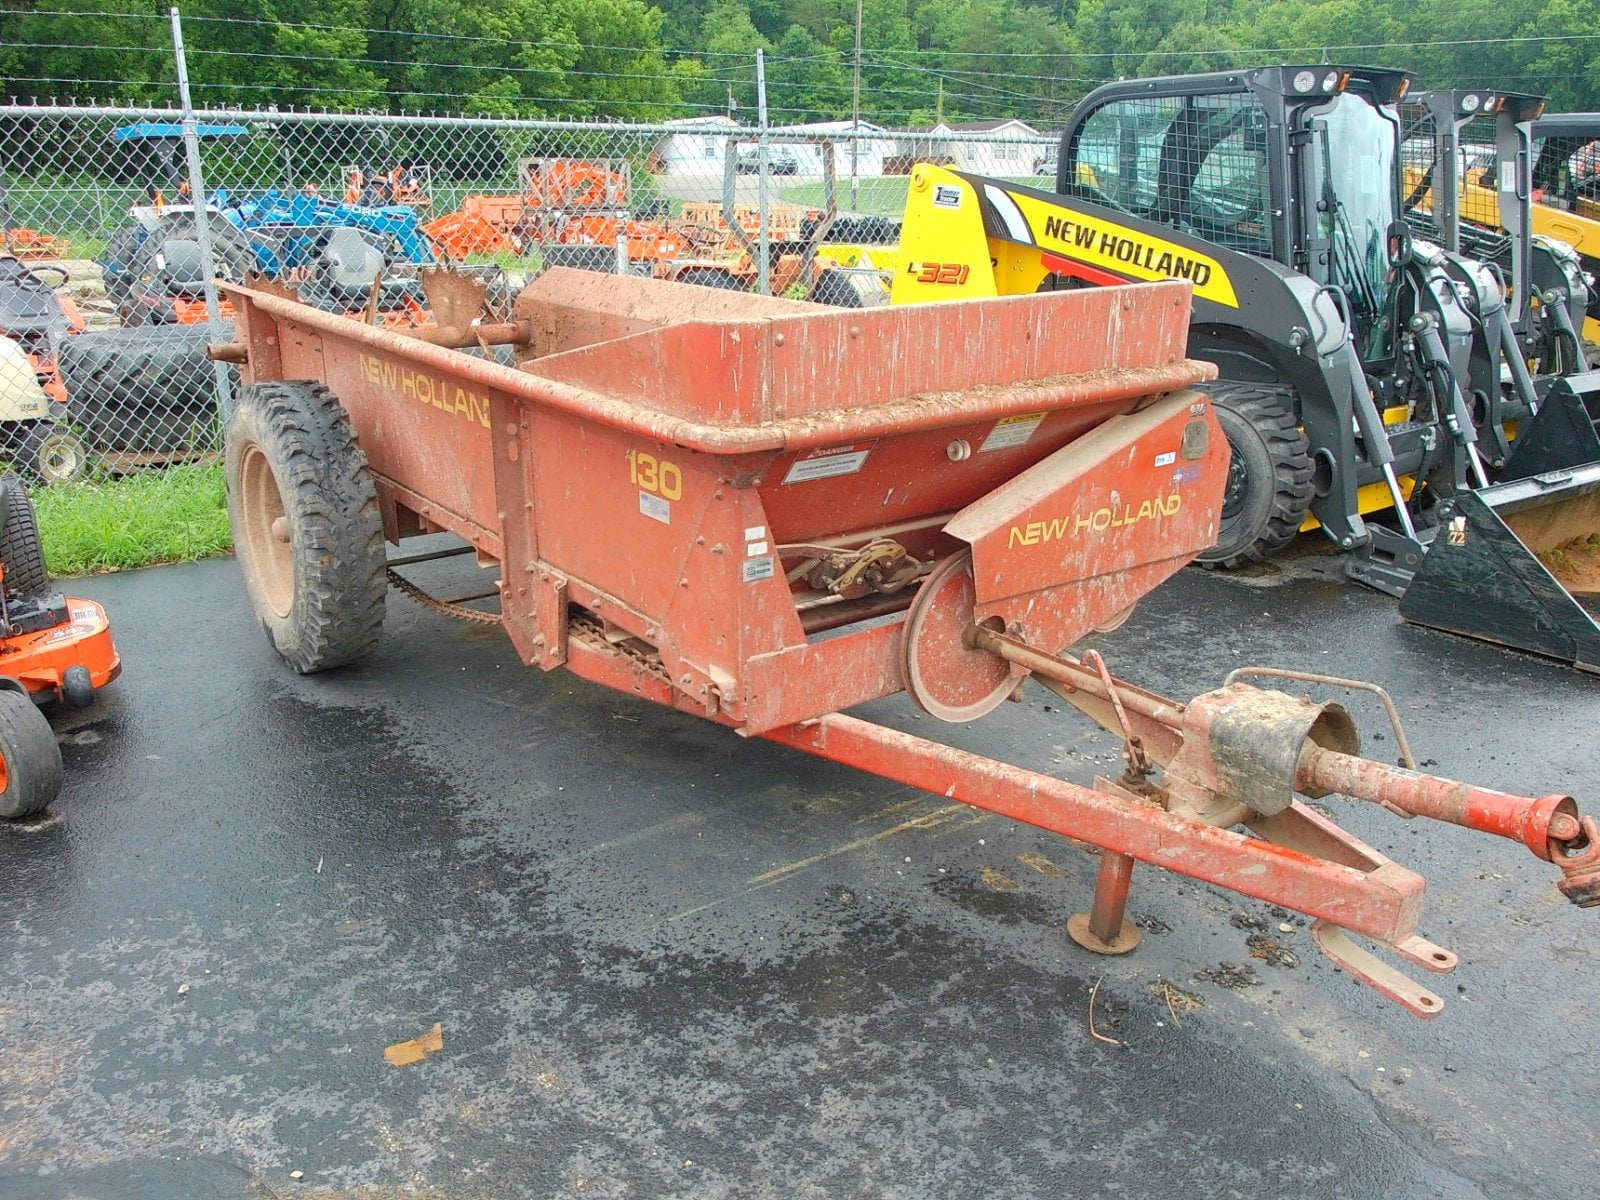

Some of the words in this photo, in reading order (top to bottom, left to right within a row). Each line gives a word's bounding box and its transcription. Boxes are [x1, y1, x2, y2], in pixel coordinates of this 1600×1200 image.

[1044, 215, 1096, 250] NEW
[1099, 233, 1211, 287] HOLLAND
[359, 353, 397, 391] NEW
[818, 445, 855, 456] DANGER
[625, 449, 683, 501] 130
[1008, 516, 1070, 549] NEW
[1073, 494, 1182, 536] HOLLAND
[1449, 531, 1466, 545] 72
